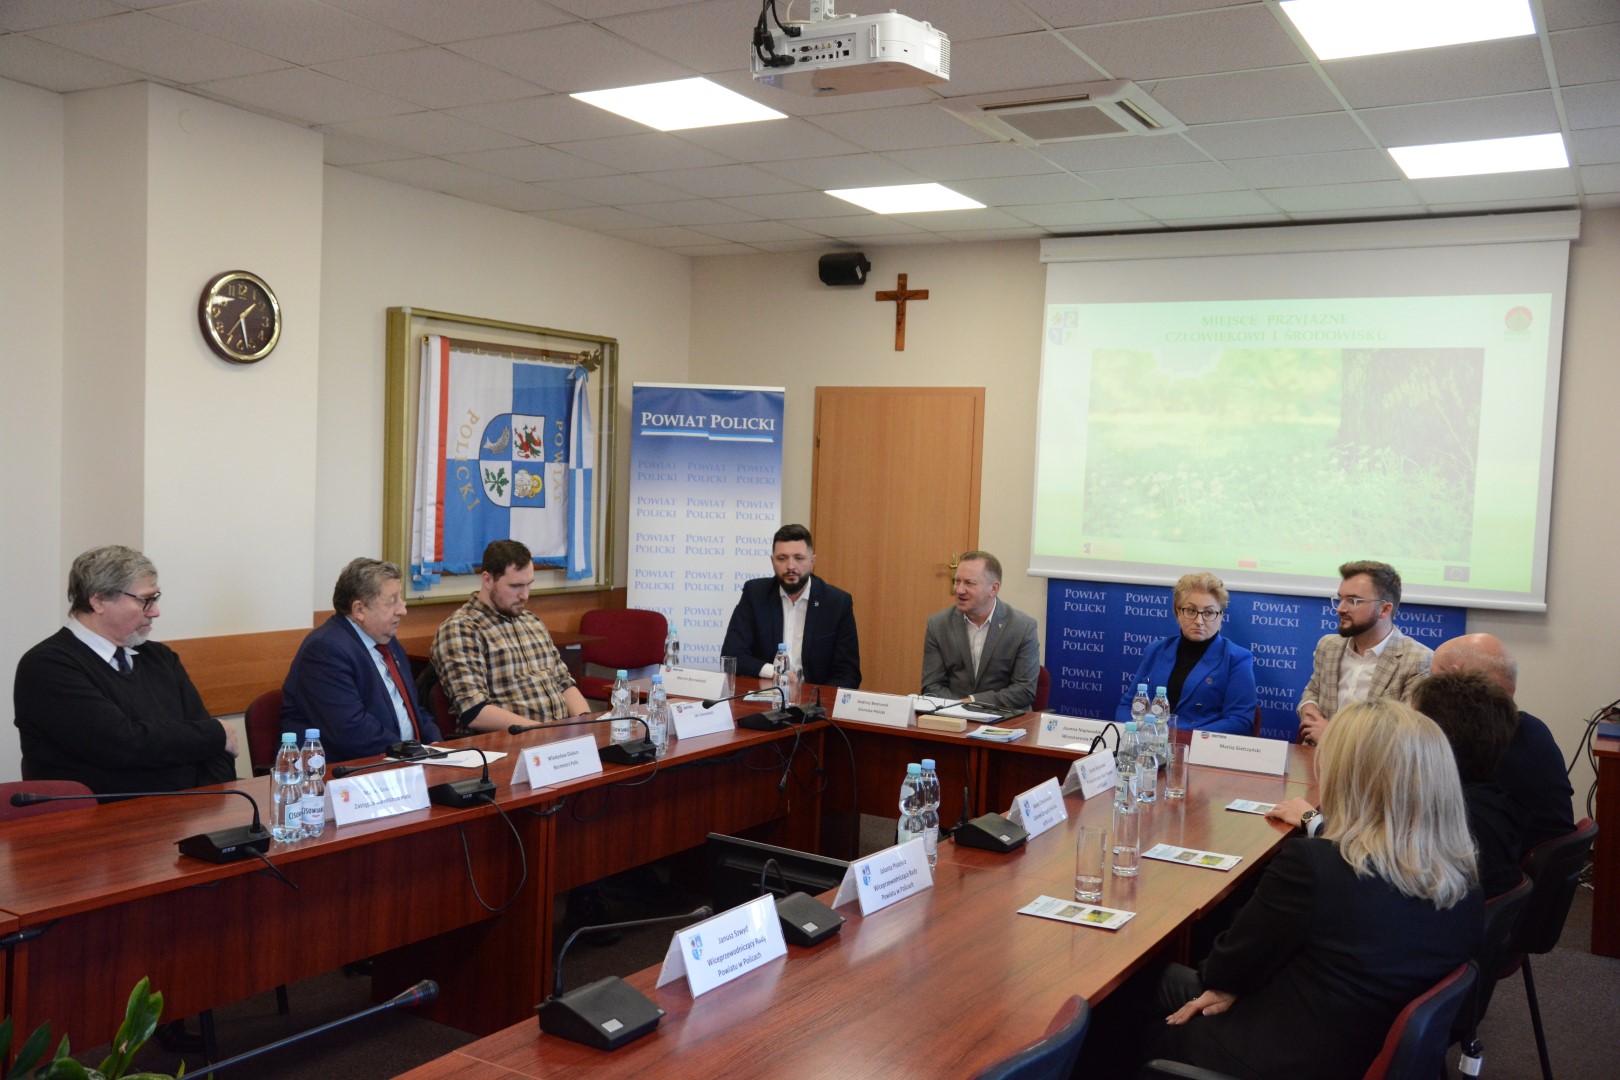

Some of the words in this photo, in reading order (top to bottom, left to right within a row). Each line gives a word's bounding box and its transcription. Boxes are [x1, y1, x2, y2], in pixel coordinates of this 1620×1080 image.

[262, 316, 270, 328] 3
[1201, 315, 1258, 327] MIEJSCE
[641, 412, 706, 428] POWIAT
[710, 414, 775, 430] POLICKI
[454, 408, 480, 511] POLICKI
[551, 420, 564, 504] POWIAT
[637, 496, 676, 506] POWIAT
[687, 498, 726, 508] POWIAT
[736, 500, 774, 509] POWIAT
[636, 508, 676, 518] POLICKI
[686, 510, 726, 520] POLICKI
[736, 512, 774, 520] POLICKI
[636, 532, 676, 542] POWIAT
[686, 534, 725, 544] POWIAT
[636, 544, 676, 554] POLICKI
[686, 546, 724, 556] POLICKI
[735, 547, 771, 556] POLICK
[635, 569, 675, 578] POWIAT
[684, 570, 724, 580] POWIAT
[634, 580, 674, 590] POLICKI
[684, 582, 724, 592] POLICKI
[1065, 588, 1106, 600] POWIAT
[1126, 592, 1168, 605] POWIAT
[684, 606, 724, 616] POWIAT
[1064, 602, 1106, 614] POLICKI
[1124, 606, 1168, 618] POLICKI
[1252, 601, 1300, 614] POWIAT
[684, 618, 723, 628] POLICKI
[1252, 614, 1299, 628] POLICKI
[1063, 628, 1104, 640] POWIAT
[1062, 640, 1104, 652] POLICKI
[1250, 642, 1298, 656] POWIAT
[682, 654, 720, 664] POLICK
[1062, 666, 1103, 678] POWIAT
[1061, 680, 1102, 692] POLICKI
[1256, 686, 1295, 698] OWIAT
[1060, 705, 1102, 717] POWIAT
[1256, 700, 1294, 711] OLICKI
